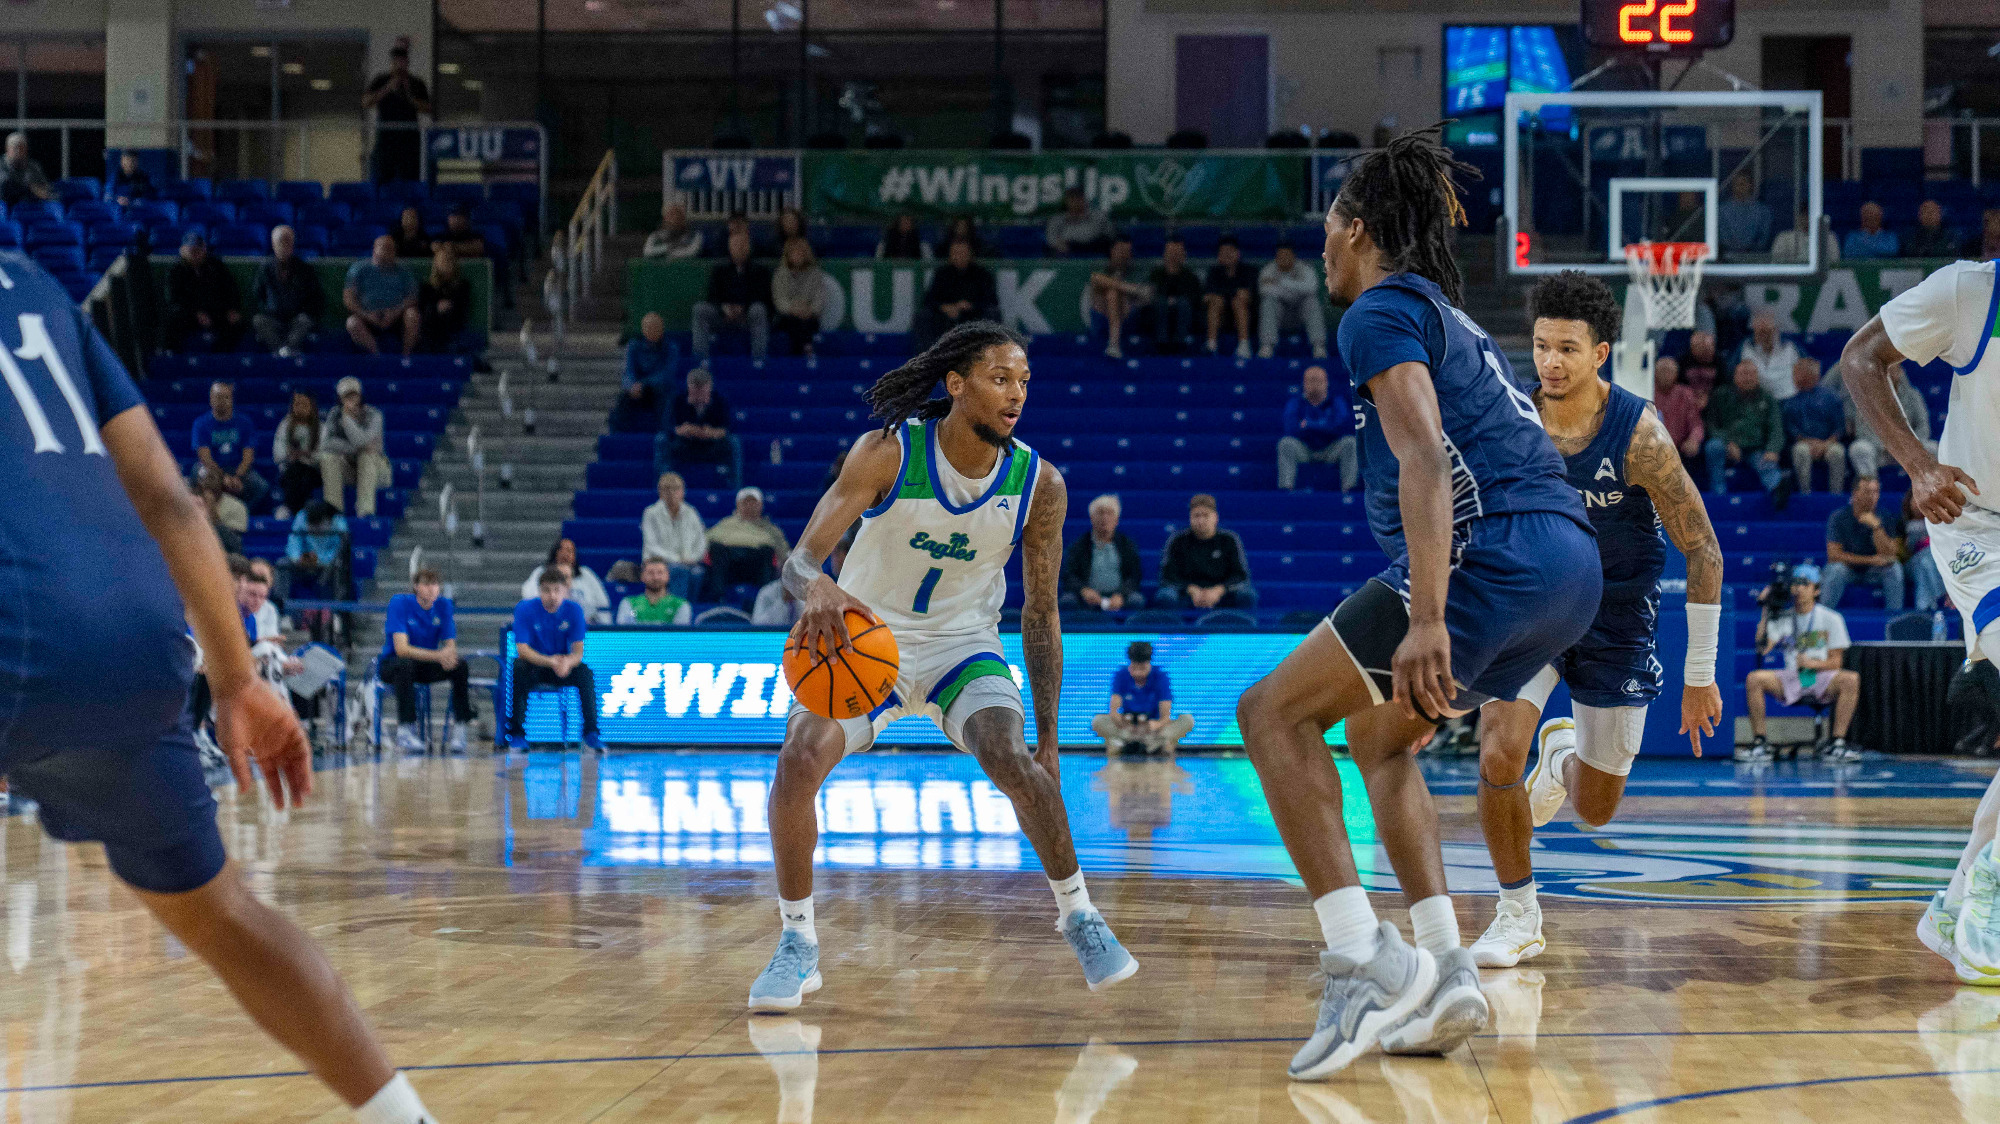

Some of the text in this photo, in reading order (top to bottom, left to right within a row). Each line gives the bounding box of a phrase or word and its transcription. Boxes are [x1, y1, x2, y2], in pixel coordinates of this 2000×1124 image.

[1619, 0, 1697, 43] 22
[458, 128, 504, 161] UU
[707, 158, 755, 191] VV
[0, 313, 107, 457] 11
[1577, 488, 1625, 508] ENS
[909, 531, 978, 562] Eagles
[911, 566, 944, 615] 1
